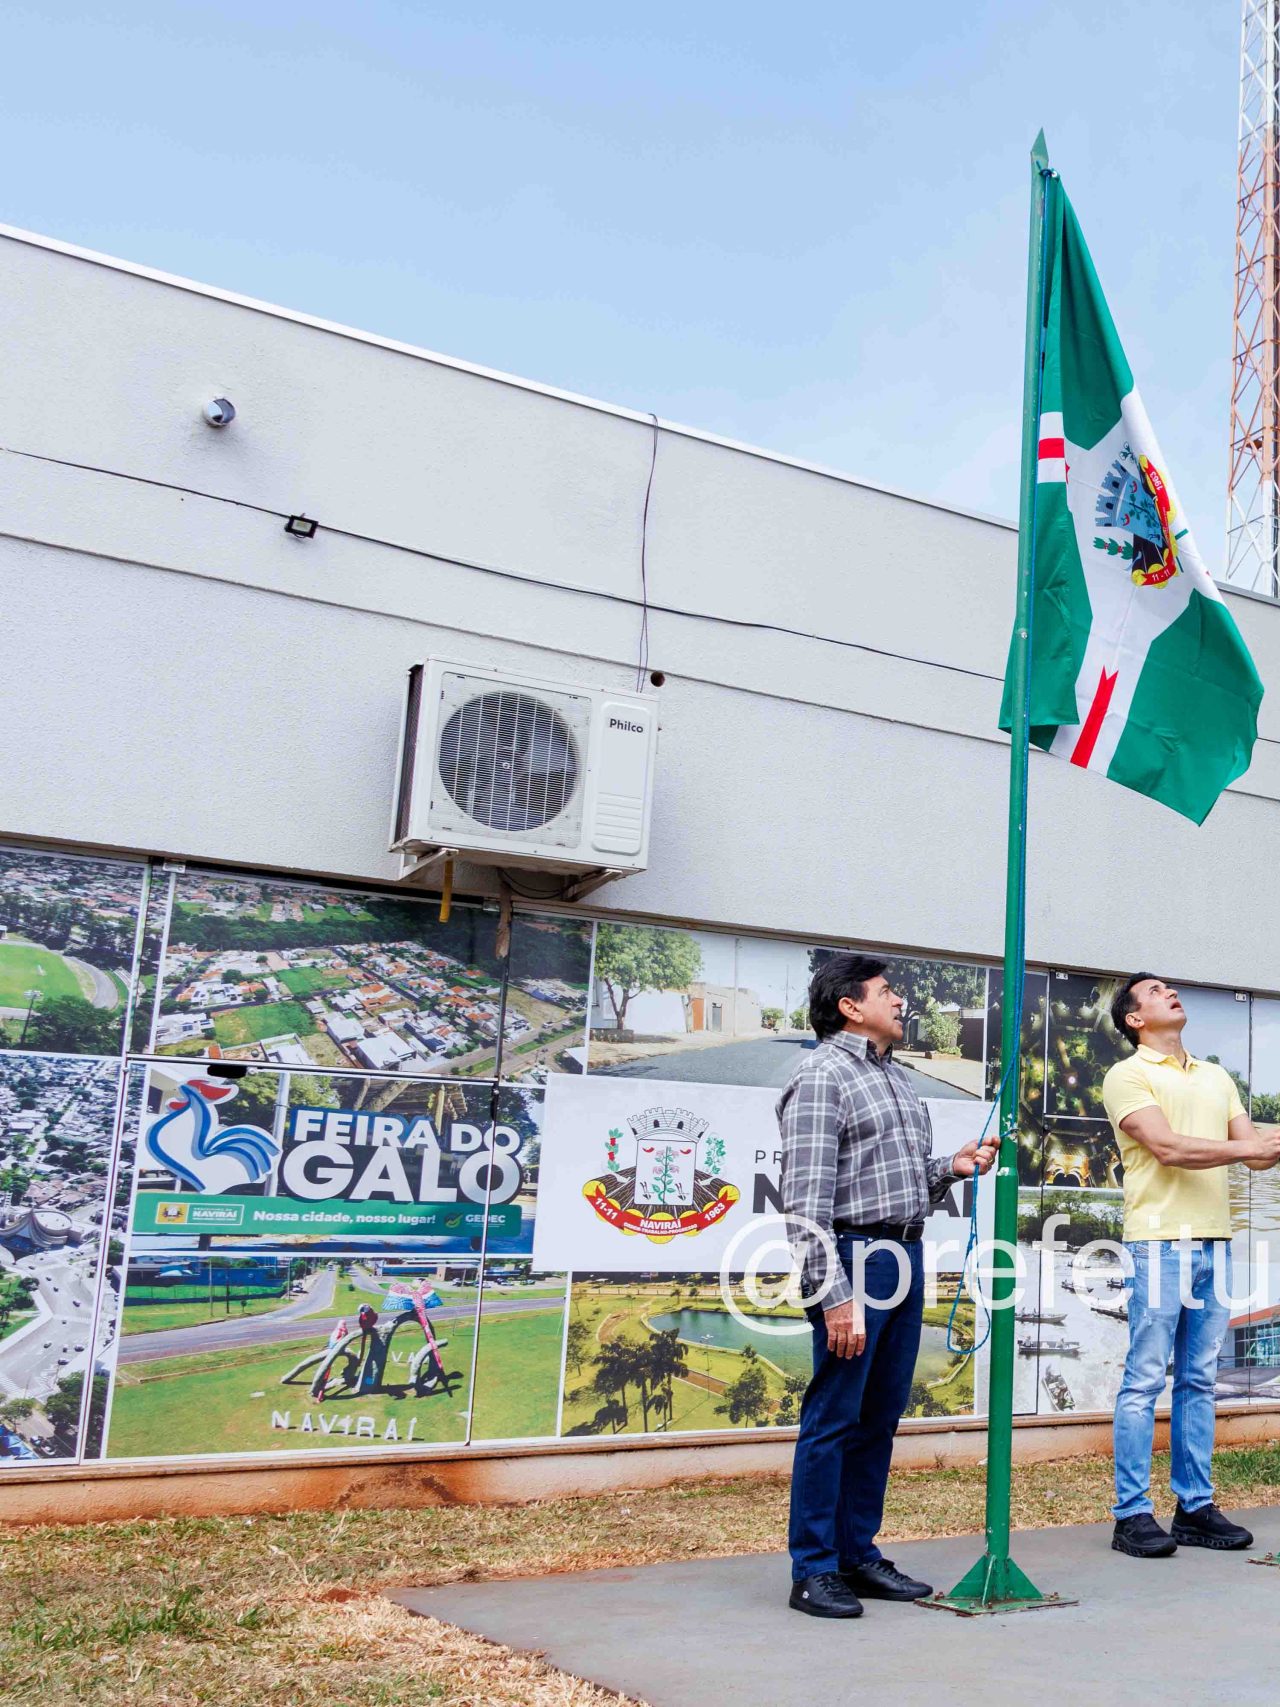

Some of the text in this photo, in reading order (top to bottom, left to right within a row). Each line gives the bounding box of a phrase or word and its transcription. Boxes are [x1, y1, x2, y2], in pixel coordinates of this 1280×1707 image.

[609, 718, 644, 733] Philco
[294, 1109, 521, 1156] FEIRA DO
[283, 1140, 521, 1205] GALO
[253, 1210, 436, 1226] Nossa cidade, nosso lugar!
[595, 1197, 618, 1220] 11-11
[703, 1202, 726, 1221] 1963
[639, 1218, 682, 1230] NAVIRAÍ
